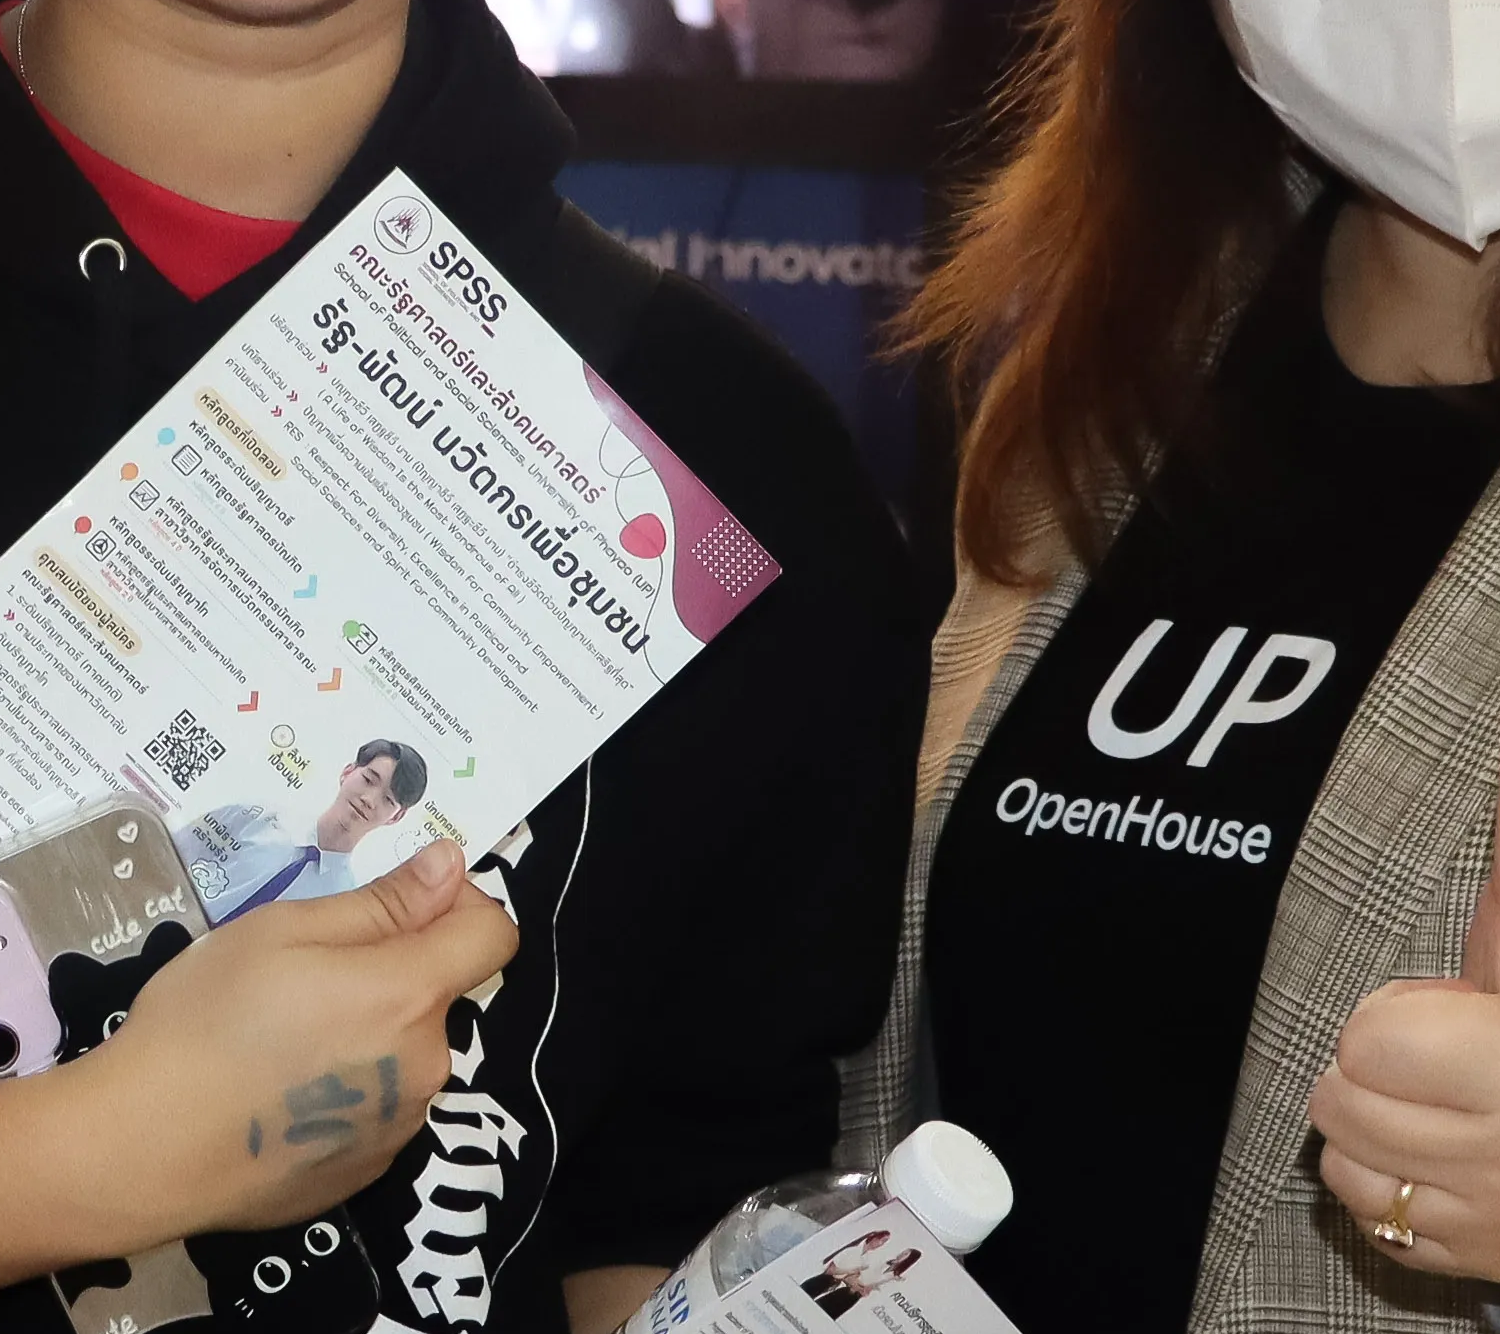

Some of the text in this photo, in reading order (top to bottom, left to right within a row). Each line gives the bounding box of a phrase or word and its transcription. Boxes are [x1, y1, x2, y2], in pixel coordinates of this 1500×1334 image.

[428, 240, 508, 323] SPSS
[347, 243, 607, 504] คณะรัฐศาสตร์และสังคมศาสตร์
[187, 419, 296, 527] หลักสูตรระดับปริญญาตรี
[199, 393, 282, 478] หลักสูตรที่เปิดสอน
[312, 296, 444, 430] รัฐ-พัฒน์
[431, 424, 654, 655] นวัตกรเพื่อชุมชน
[332, 261, 656, 600] School of Political and Social Sciences, University of Phayao (UP)
[108, 514, 209, 618] หลักสูตรระดับปริญญาโท
[198, 467, 303, 574] หลักสูตรรัฐศาสตรบัณฑิต
[20, 568, 150, 695] คณะรัฐศาสตร์และสังคมศาสตร์
[37, 552, 135, 650] คุณสมบัติของผู้สมัคร
[13, 621, 128, 736] ตามประกาศของมหาวิทยาลัย
[1087, 618, 1337, 768] UP
[995, 777, 1272, 865] OpenHouse
[145, 884, 187, 919] cat
